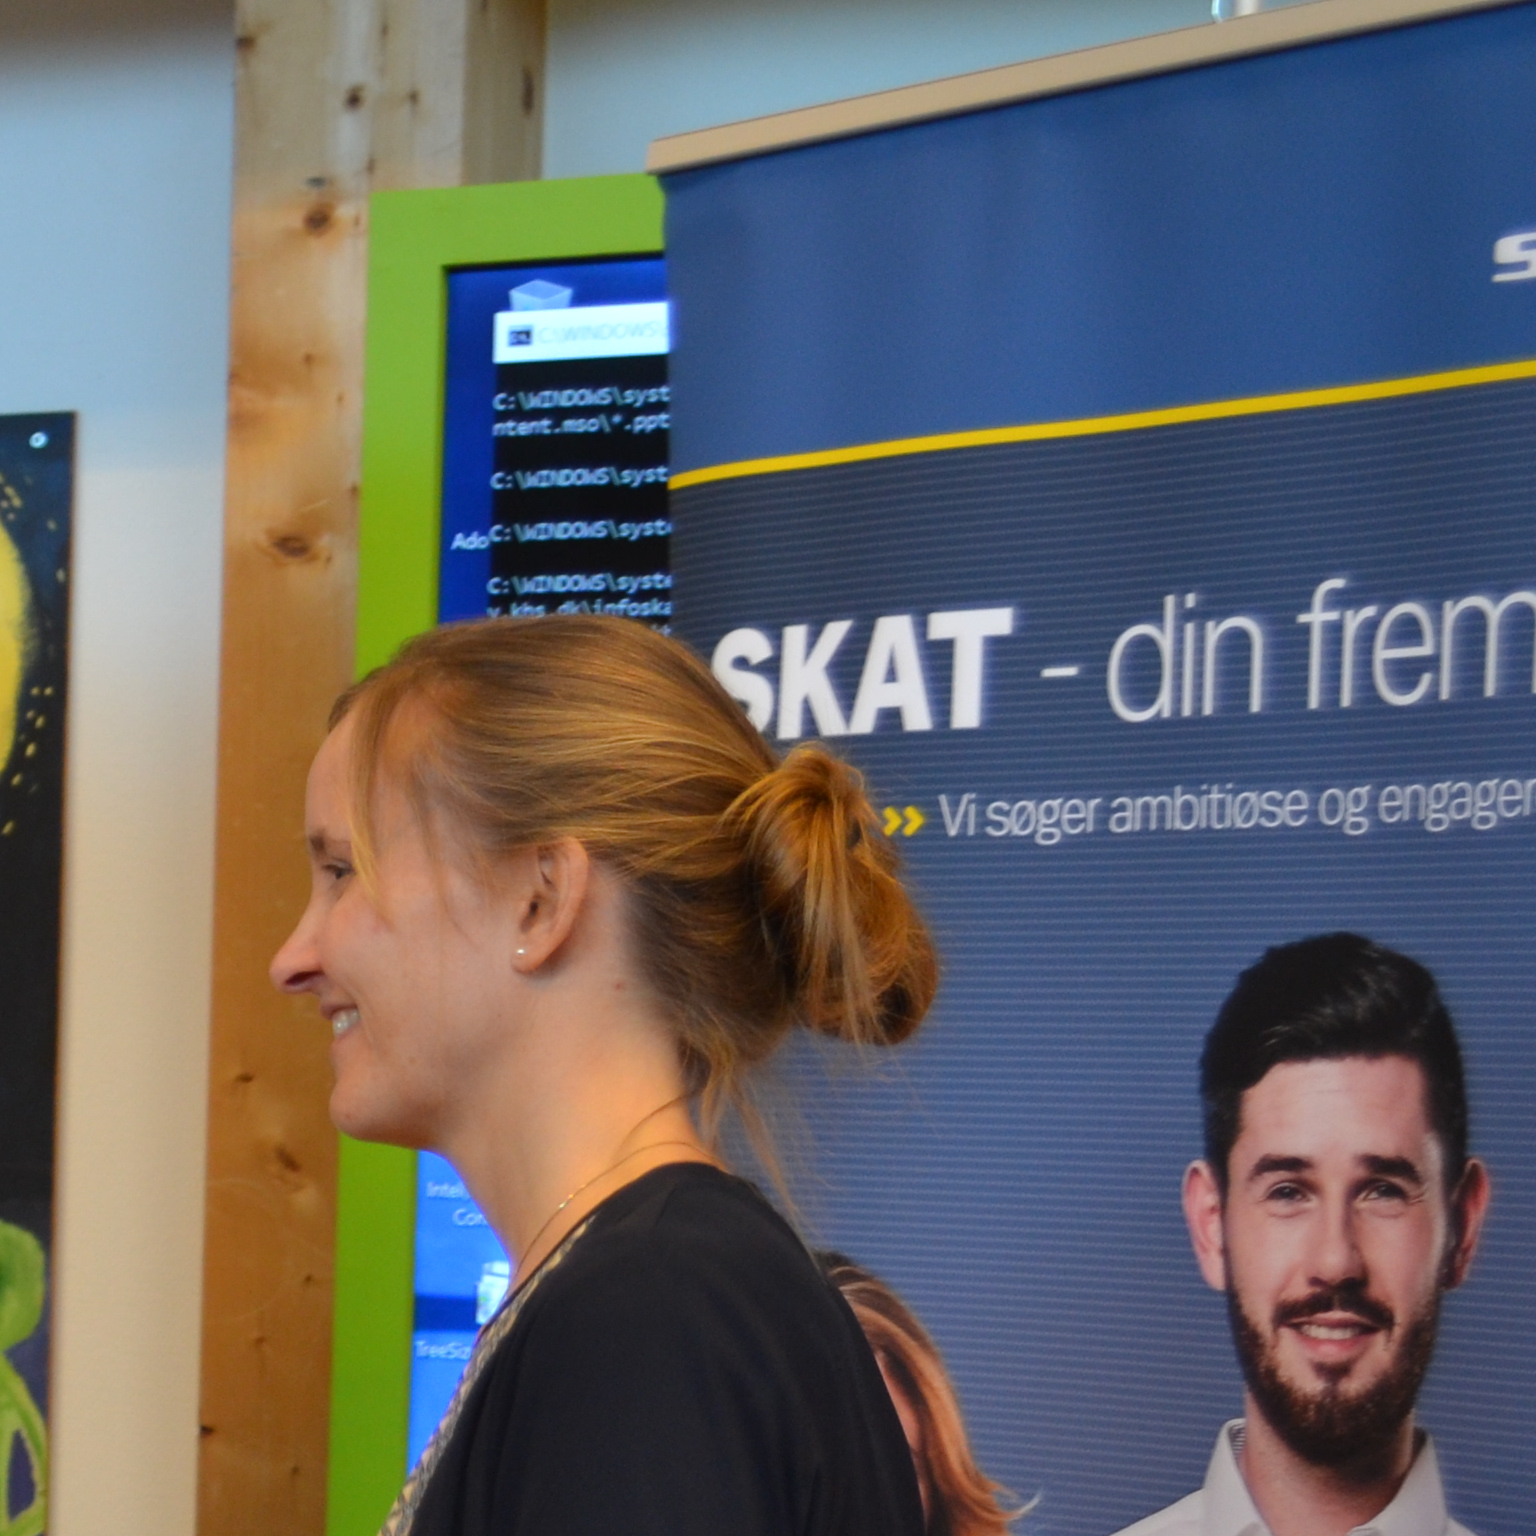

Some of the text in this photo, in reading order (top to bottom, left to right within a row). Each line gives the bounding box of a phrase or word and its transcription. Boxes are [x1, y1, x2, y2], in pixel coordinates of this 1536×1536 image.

[710, 607, 1014, 740] SKAT
[1106, 593, 1264, 723] din
[1295, 578, 1536, 711] frem
[937, 792, 977, 838] Vi
[985, 797, 1102, 846] søger
[1108, 782, 1310, 834] ambitiøse
[1318, 784, 1372, 837] og
